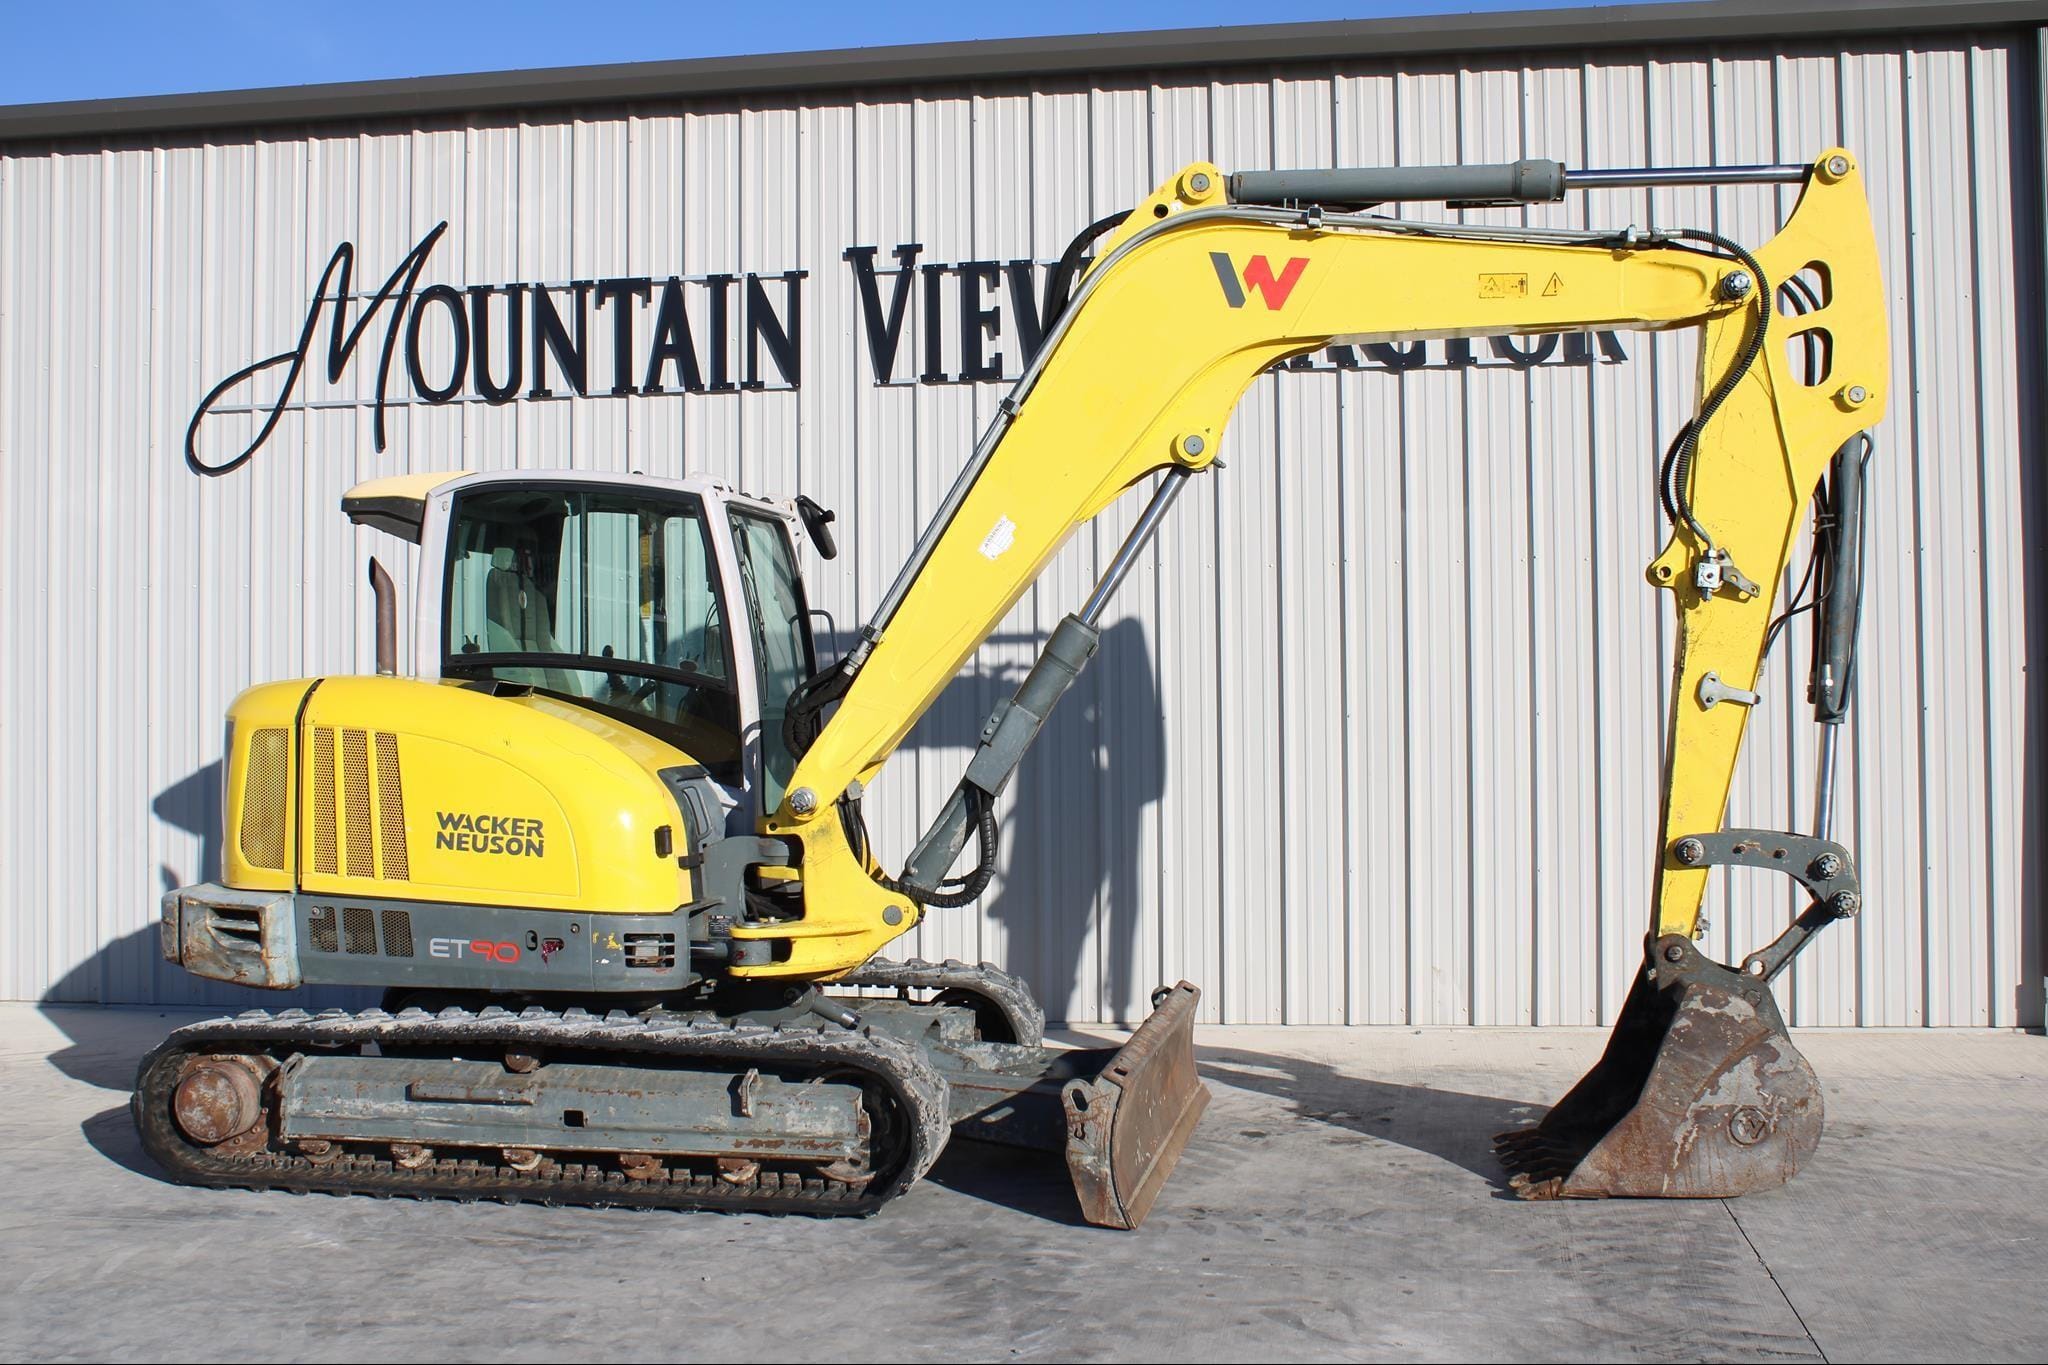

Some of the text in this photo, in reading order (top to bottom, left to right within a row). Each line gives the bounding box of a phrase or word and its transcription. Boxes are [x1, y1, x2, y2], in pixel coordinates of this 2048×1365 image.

[185, 220, 808, 476] MOUNTAIN
[436, 811, 544, 838] WACKER
[436, 831, 544, 858] NEUSON
[429, 937, 521, 964] ET90
